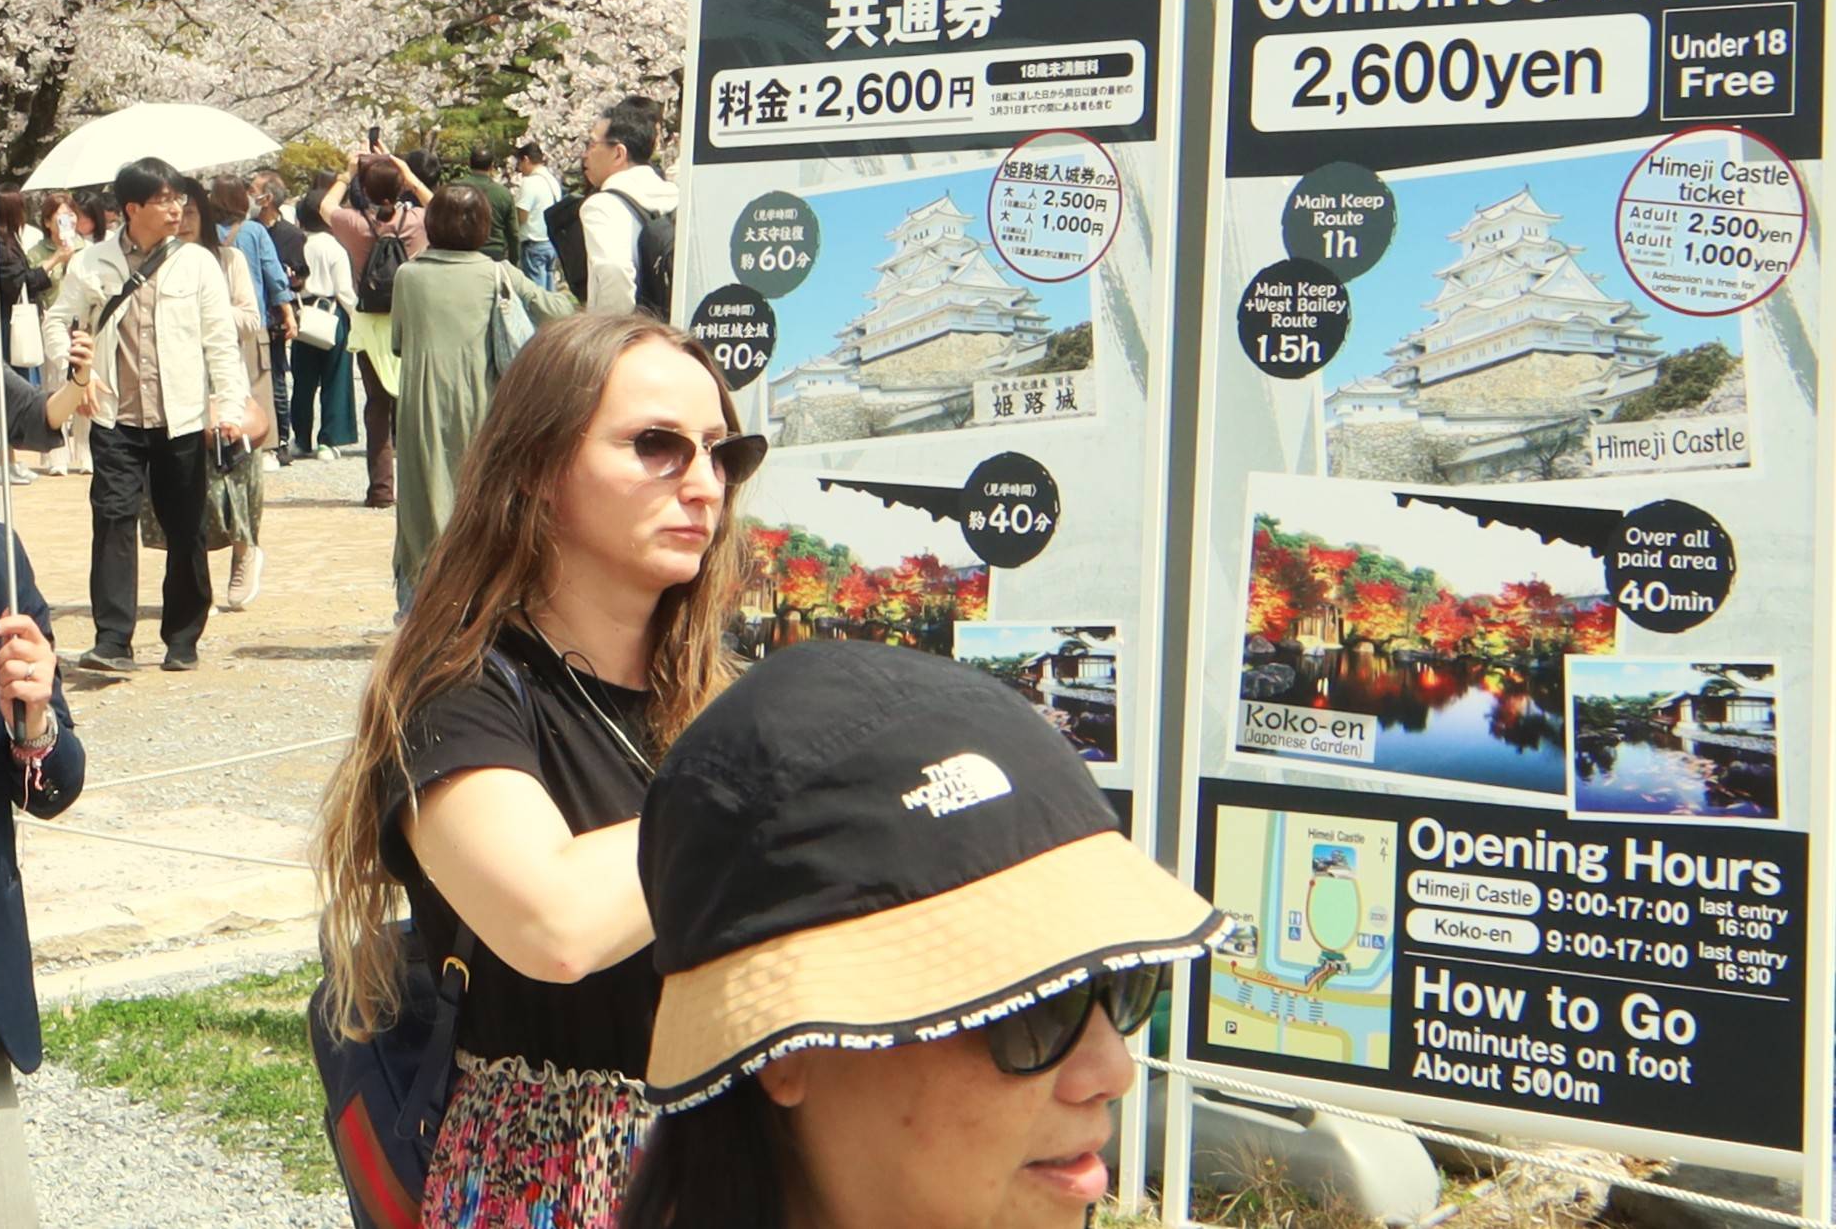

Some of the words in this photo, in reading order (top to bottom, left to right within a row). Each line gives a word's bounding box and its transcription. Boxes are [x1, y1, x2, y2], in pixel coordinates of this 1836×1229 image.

[1671, 32, 1749, 62] Under
[1755, 28, 1787, 56] 18
[1291, 37, 1603, 116] 2,600yen
[1680, 66, 1776, 99] Free
[1648, 155, 1714, 182] Himeji
[1721, 161, 1789, 186] Castle
[1294, 194, 1336, 209] Main
[1341, 194, 1384, 210] Keep
[1679, 182, 1745, 206] ticket
[1314, 211, 1364, 226] Route
[1630, 205, 1678, 223] Adult
[1688, 213, 1792, 244] 2,500yen
[1322, 230, 1358, 259] 1h
[1624, 231, 1673, 249] Adult
[1685, 242, 1788, 273] 1,000yen
[1254, 282, 1292, 297] Main
[1297, 282, 1337, 298] Keep
[1651, 271, 1702, 286] Admission
[1741, 279, 1756, 291] for
[1651, 282, 1681, 294] under
[1245, 298, 1291, 313] +West
[1297, 297, 1347, 314] Bailey
[1271, 313, 1318, 328] Route
[1257, 334, 1322, 364] 1.5h
[992, 389, 1078, 419] 姫路城
[1596, 432, 1666, 463] Himeji
[1672, 428, 1746, 456] Castle
[968, 503, 1052, 535] 約40分
[1625, 526, 1678, 548] Over
[1684, 528, 1710, 549] all
[1617, 549, 1663, 571] paid
[1669, 553, 1718, 571] area
[1618, 579, 1715, 613] 40min
[1245, 703, 1365, 741] Koko-en
[1244, 728, 1307, 749] (Japanese
[1310, 736, 1363, 758] Garden)
[921, 760, 966, 784] THE
[901, 778, 969, 810] NORTH
[928, 789, 980, 818] FACE
[1308, 828, 1335, 843] Himeji
[1337, 830, 1365, 844] Castle
[1407, 816, 1608, 884] Opening
[1624, 837, 1783, 896] Hours
[1416, 878, 1470, 904] Himeji
[1475, 883, 1534, 908] Castle
[1547, 887, 1690, 926] 9:00-17:00
[1699, 896, 1734, 918] last
[1737, 905, 1789, 926] entry
[1434, 917, 1512, 944] Koko-en
[1545, 928, 1689, 969] 9:00-17:00
[1698, 940, 1733, 963] last
[1736, 948, 1788, 971] entry
[1716, 918, 1773, 941] 16:00
[1715, 962, 1772, 986] 16:30
[960, 991, 1037, 1030] NORTH
[1412, 964, 1526, 1023] How
[1547, 975, 1600, 1033] to
[1621, 991, 1698, 1047] Go
[769, 1032, 836, 1061] NORTH
[1413, 1018, 1566, 1068] 10minutes
[1577, 1045, 1616, 1073] on
[1627, 1050, 1692, 1086] foot
[1412, 1052, 1502, 1092] About
[1512, 1067, 1600, 1106] 500m
